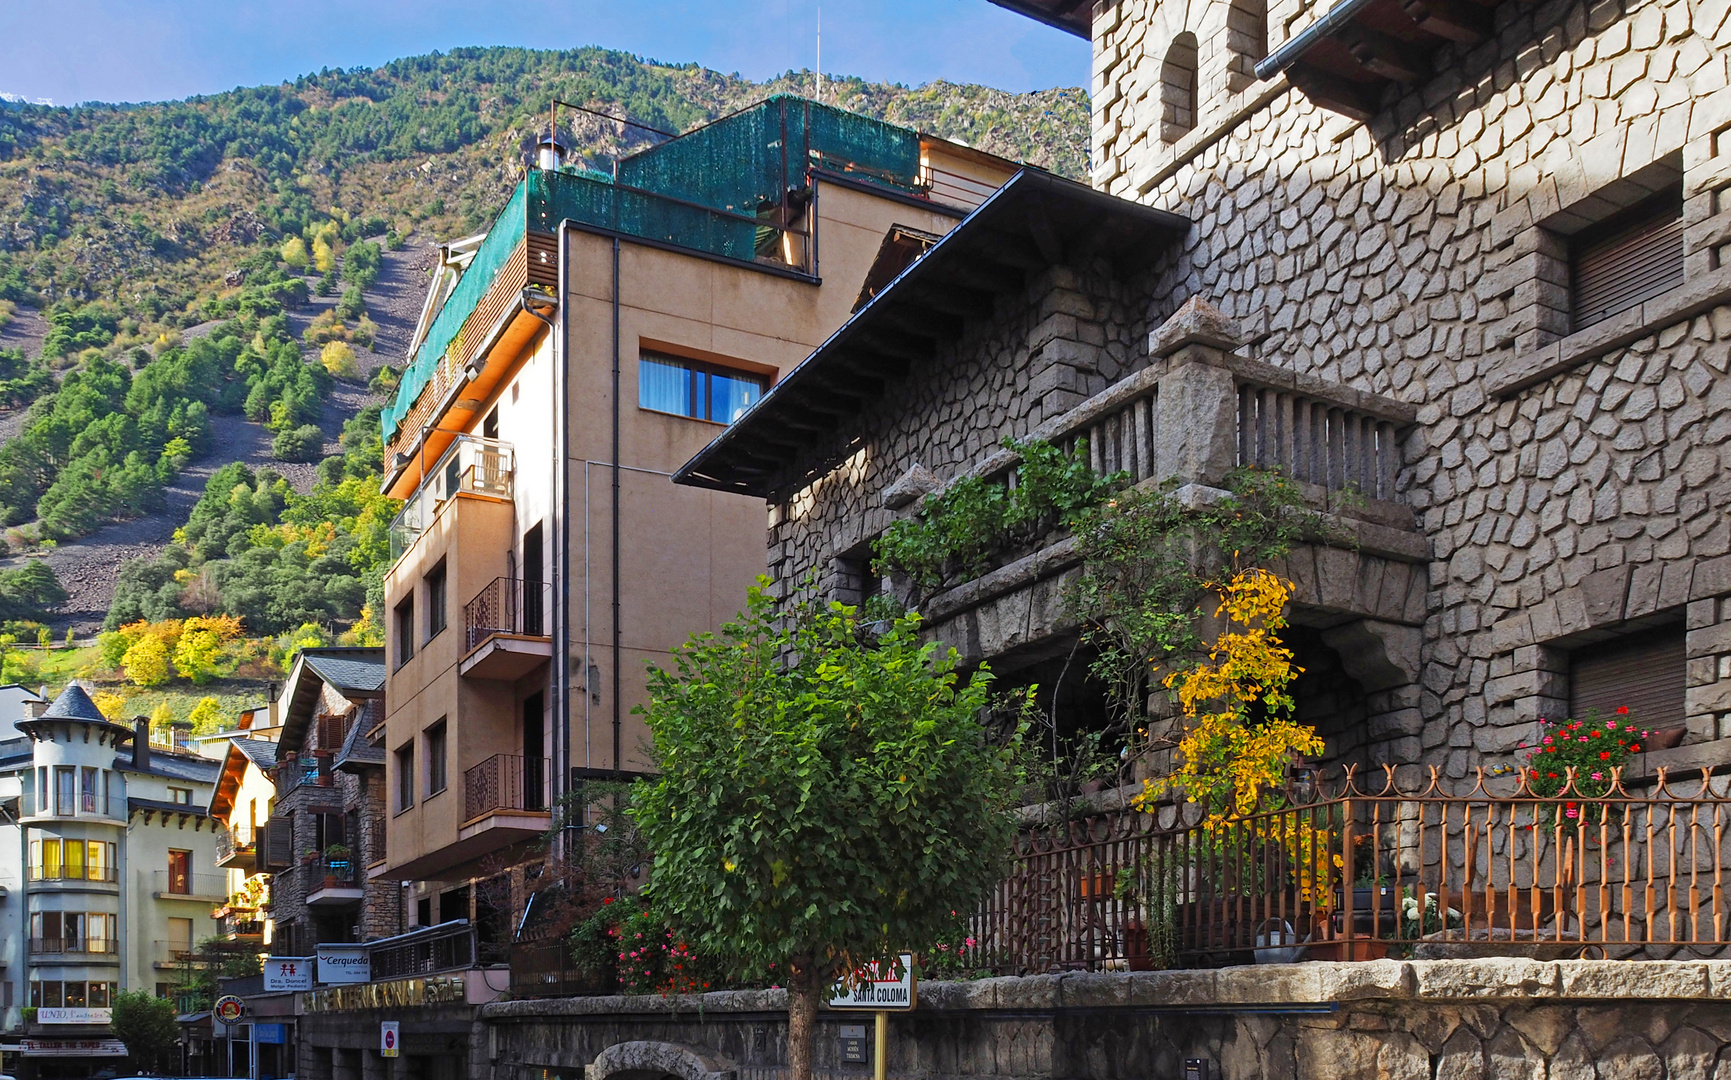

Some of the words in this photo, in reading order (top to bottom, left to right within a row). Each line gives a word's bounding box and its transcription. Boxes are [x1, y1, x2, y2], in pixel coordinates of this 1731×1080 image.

[326, 956, 369, 968] Cerqueda
[853, 988, 875, 1002] SANTA
[877, 987, 908, 1003] COLOMA
